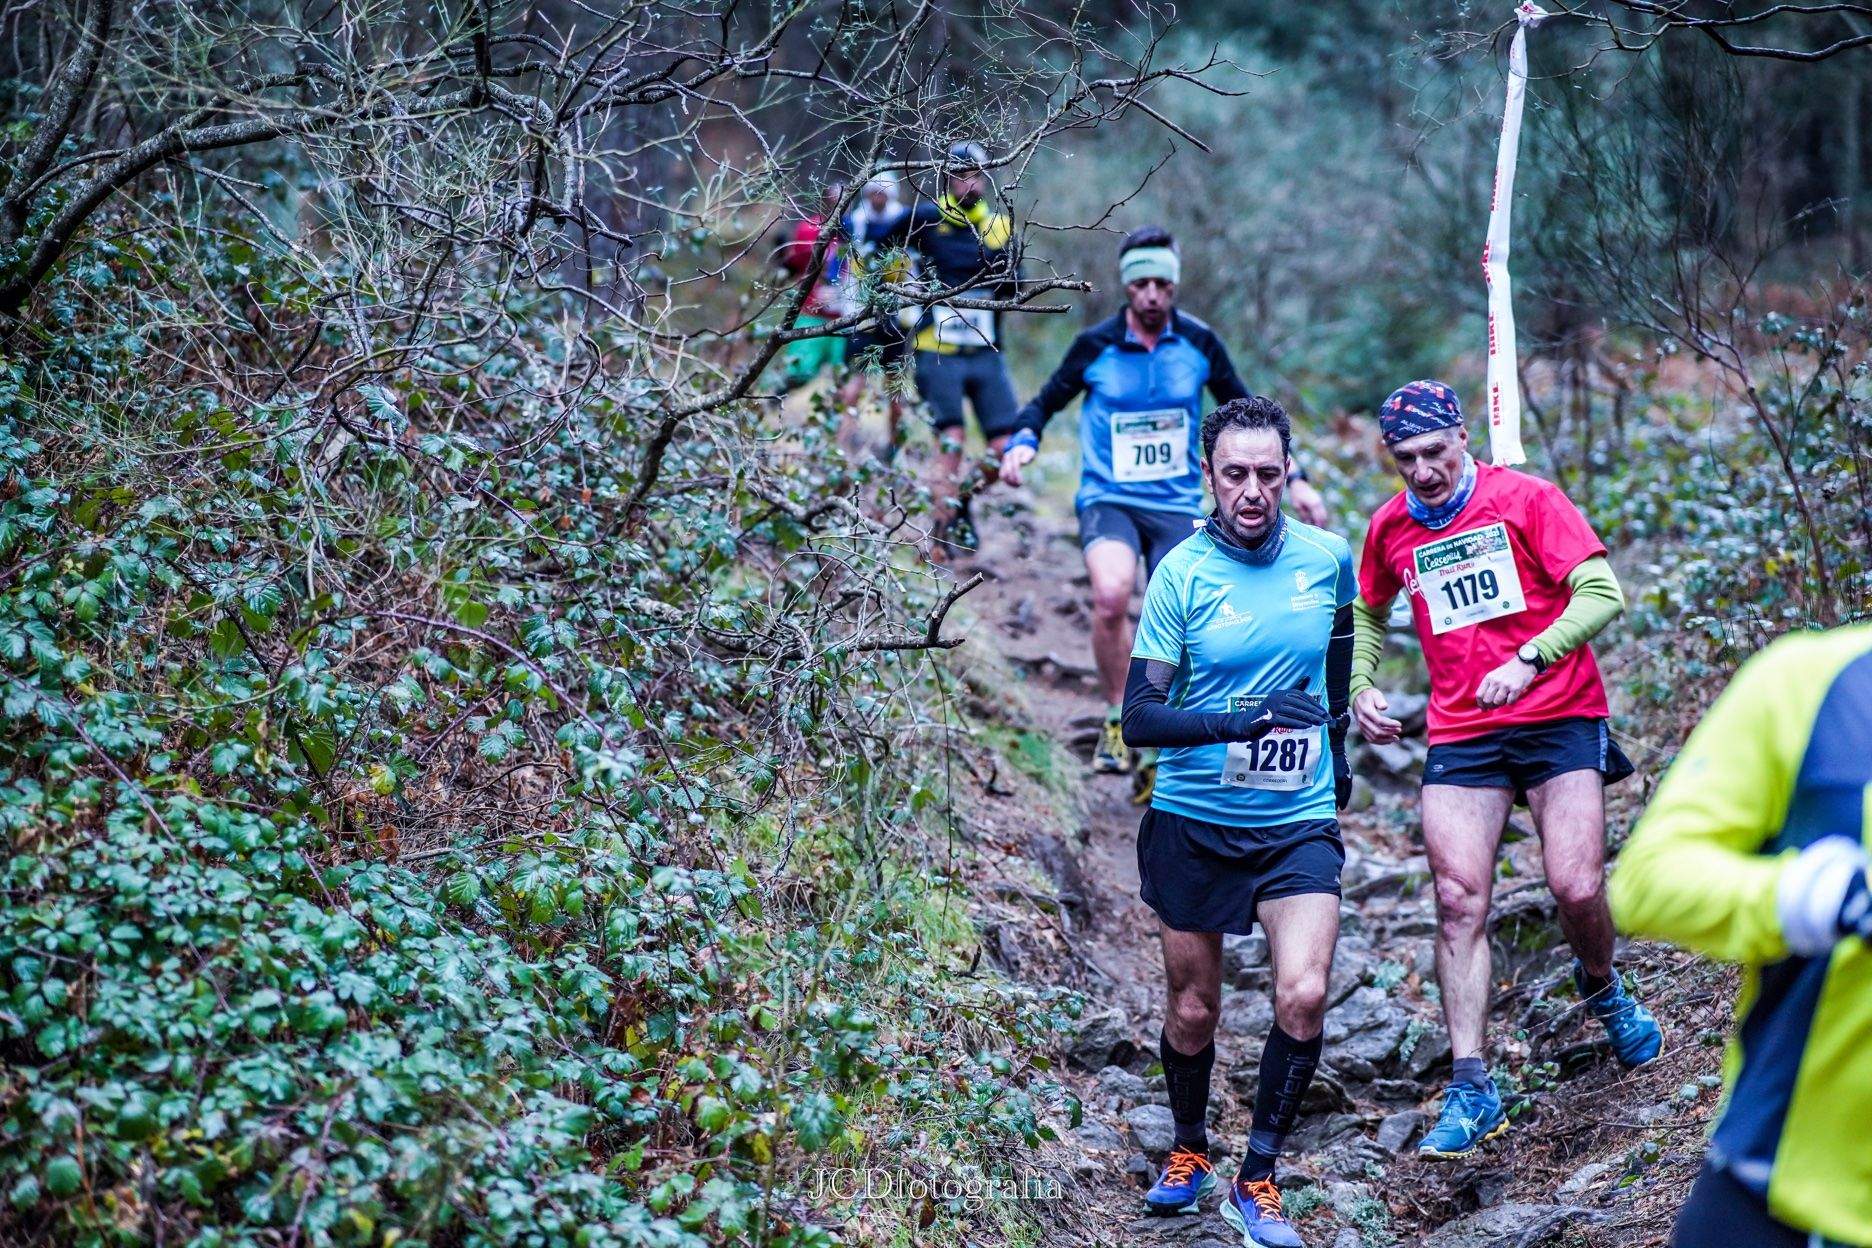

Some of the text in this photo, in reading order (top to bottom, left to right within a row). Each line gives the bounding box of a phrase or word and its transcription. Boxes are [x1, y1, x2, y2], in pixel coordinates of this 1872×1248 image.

[1133, 442, 1171, 465] 709
[1418, 545, 1446, 558] CARRERA
[1452, 533, 1485, 547] NAVIDAD
[1439, 567, 1456, 577] Trail
[1440, 569, 1500, 610] 1179
[1246, 738, 1309, 771] 1287
